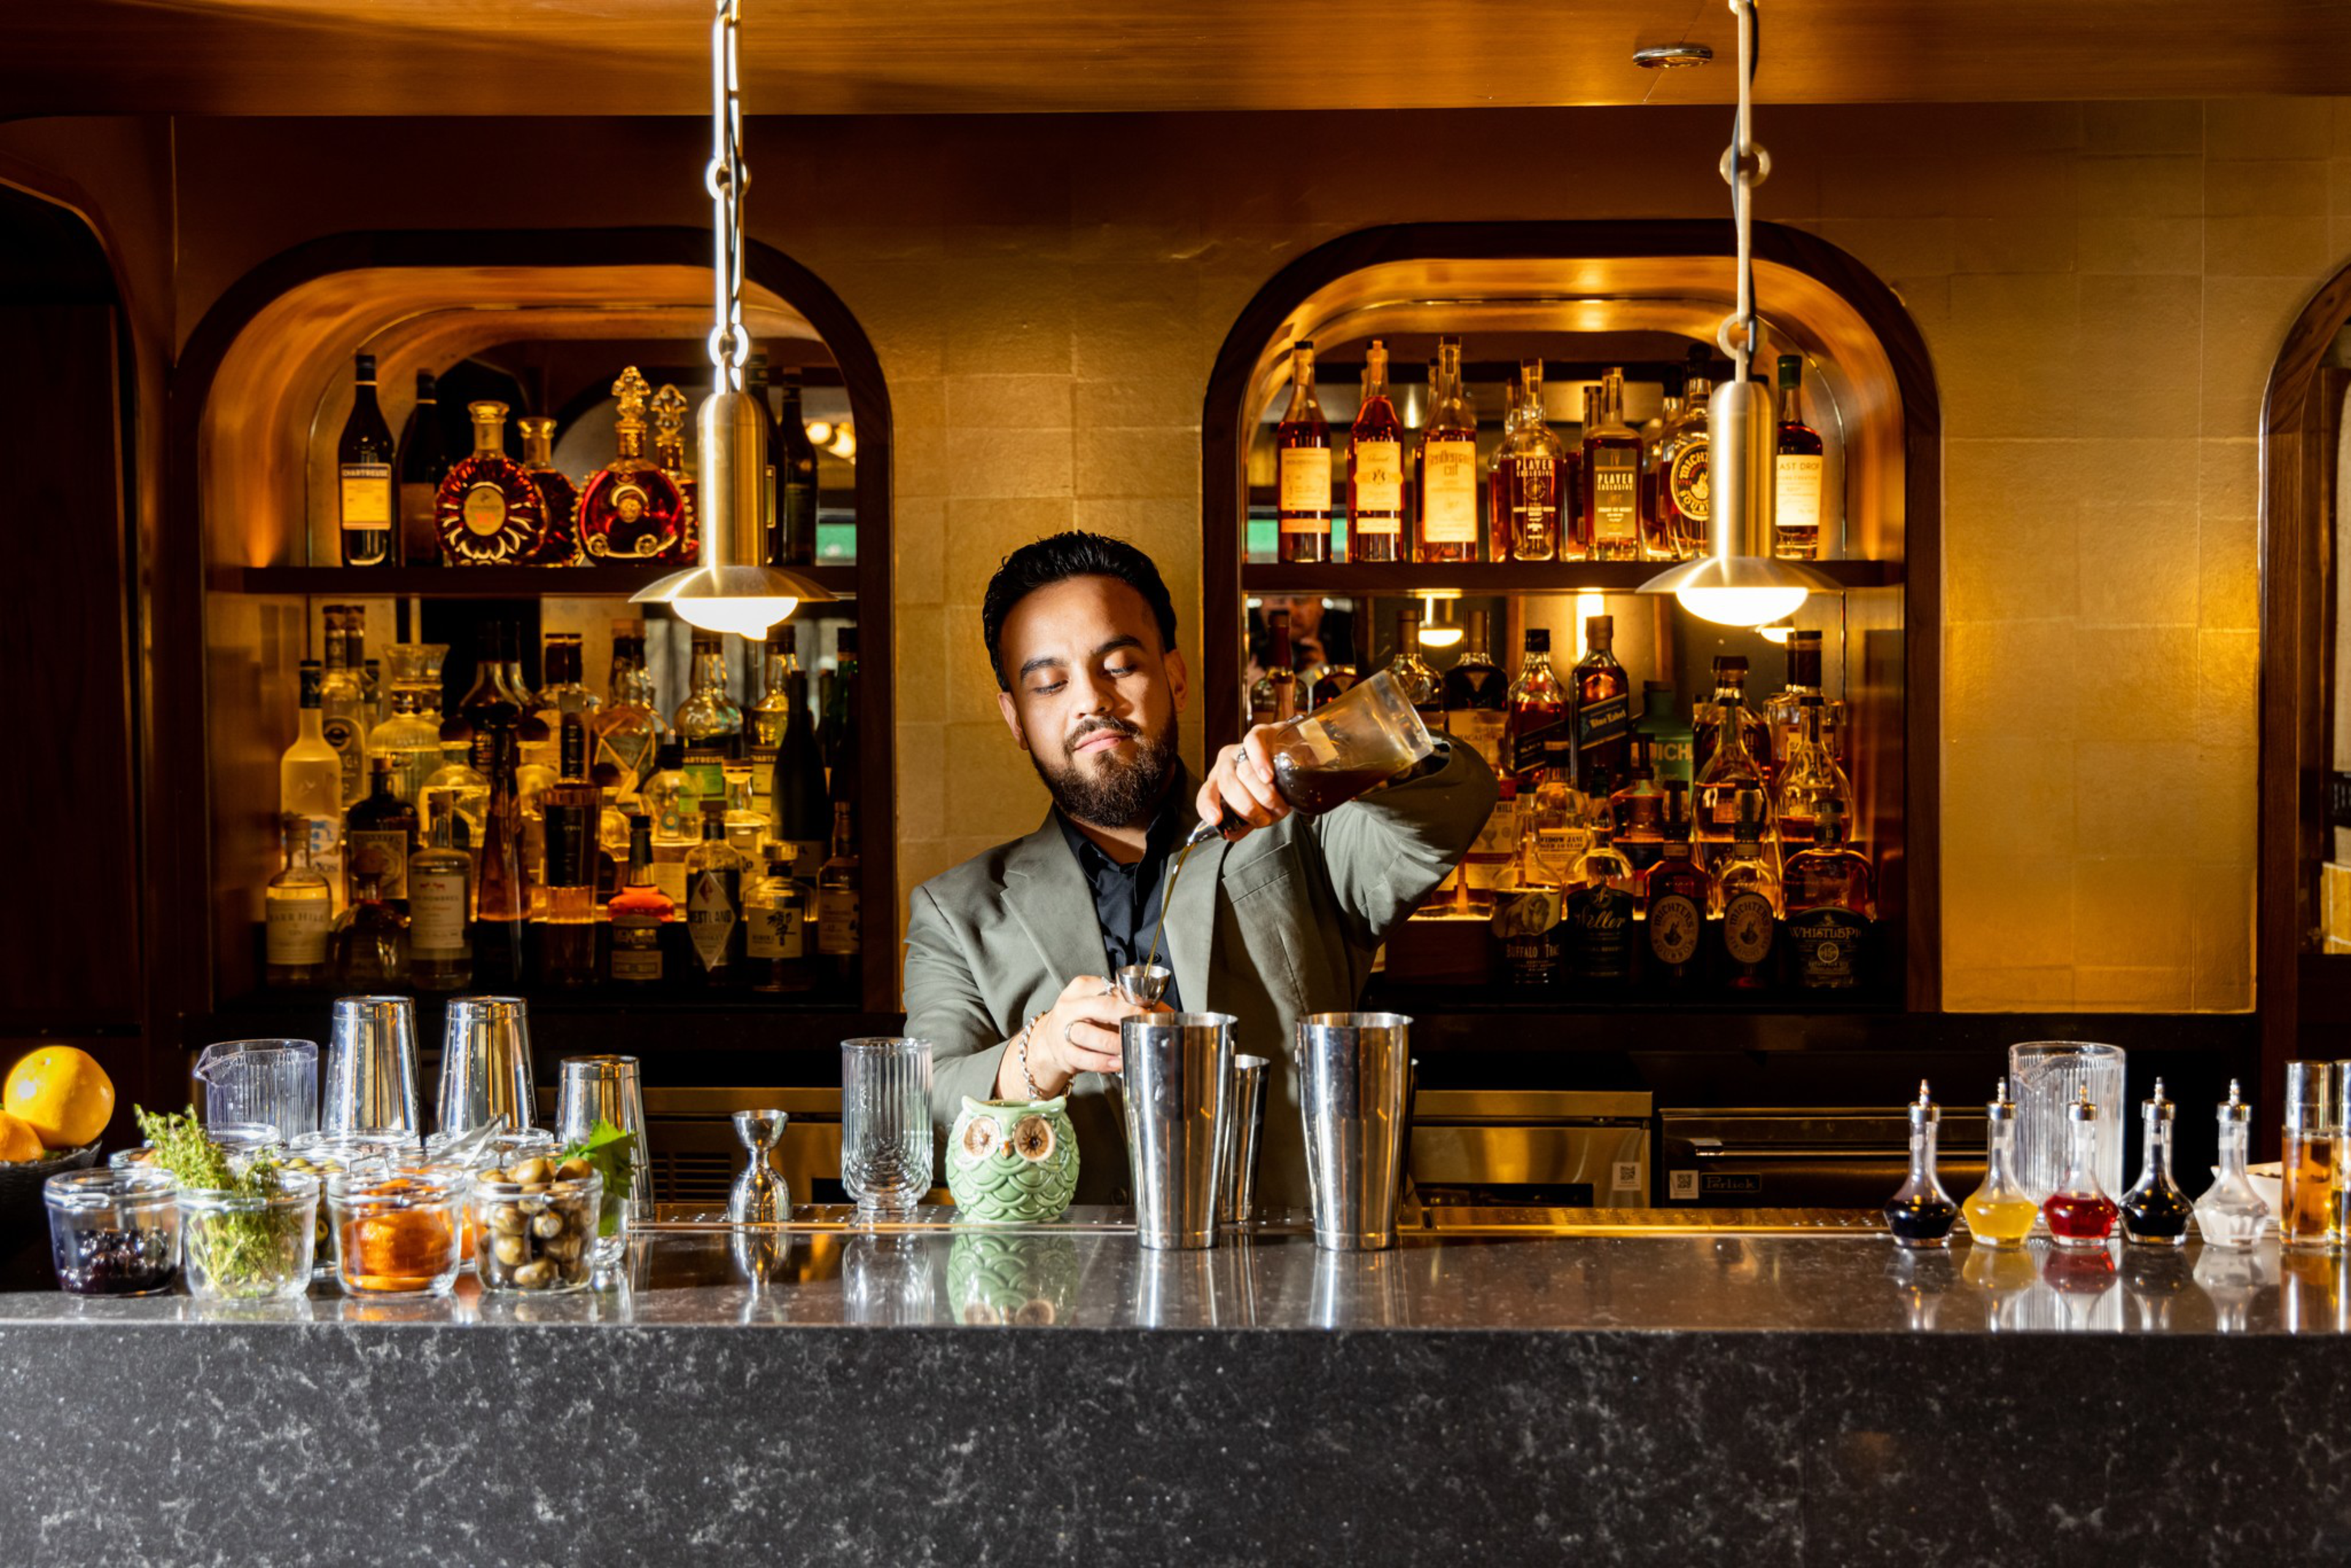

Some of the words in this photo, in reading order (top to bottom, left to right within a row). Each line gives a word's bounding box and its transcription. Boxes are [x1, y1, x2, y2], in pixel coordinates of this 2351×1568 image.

[1516, 459, 1554, 471] PLAYER
[342, 469, 389, 478] CHARTREUSE
[1597, 473, 1633, 484] PLAYER
[1589, 717, 1607, 730] Blue
[1607, 708, 1627, 724] Label
[1573, 904, 1627, 929] Weller
[1505, 943, 1539, 959] BUFFALO
[1706, 1176, 1758, 1190] Perlick
